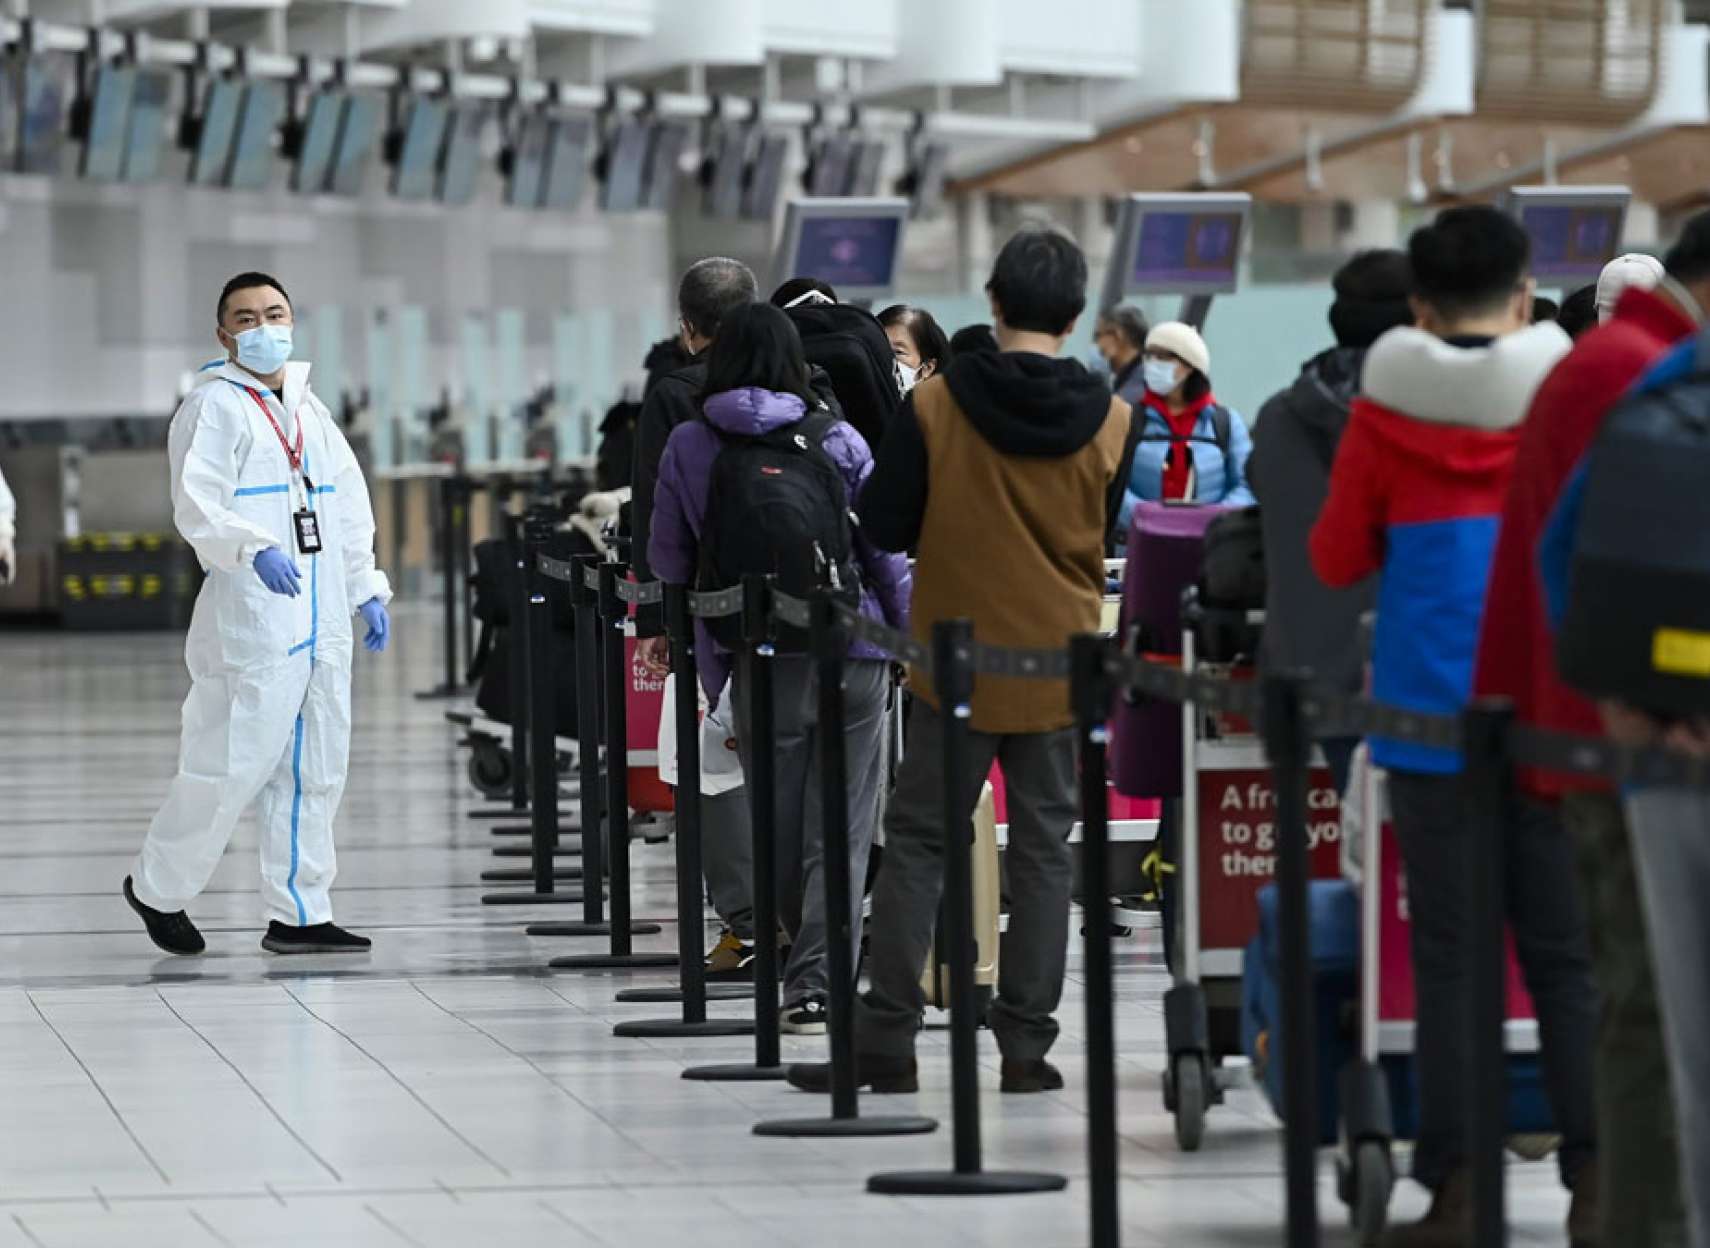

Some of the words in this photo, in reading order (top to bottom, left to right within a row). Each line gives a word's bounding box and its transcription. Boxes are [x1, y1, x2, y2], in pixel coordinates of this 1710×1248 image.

[633, 664, 647, 677] to
[633, 678, 665, 691] ther
[1220, 784, 1242, 809] A
[1247, 783, 1278, 809] fr
[1307, 788, 1338, 809] ca
[1221, 821, 1251, 843] to
[1305, 822, 1340, 850] yo
[1221, 850, 1277, 876] ther
